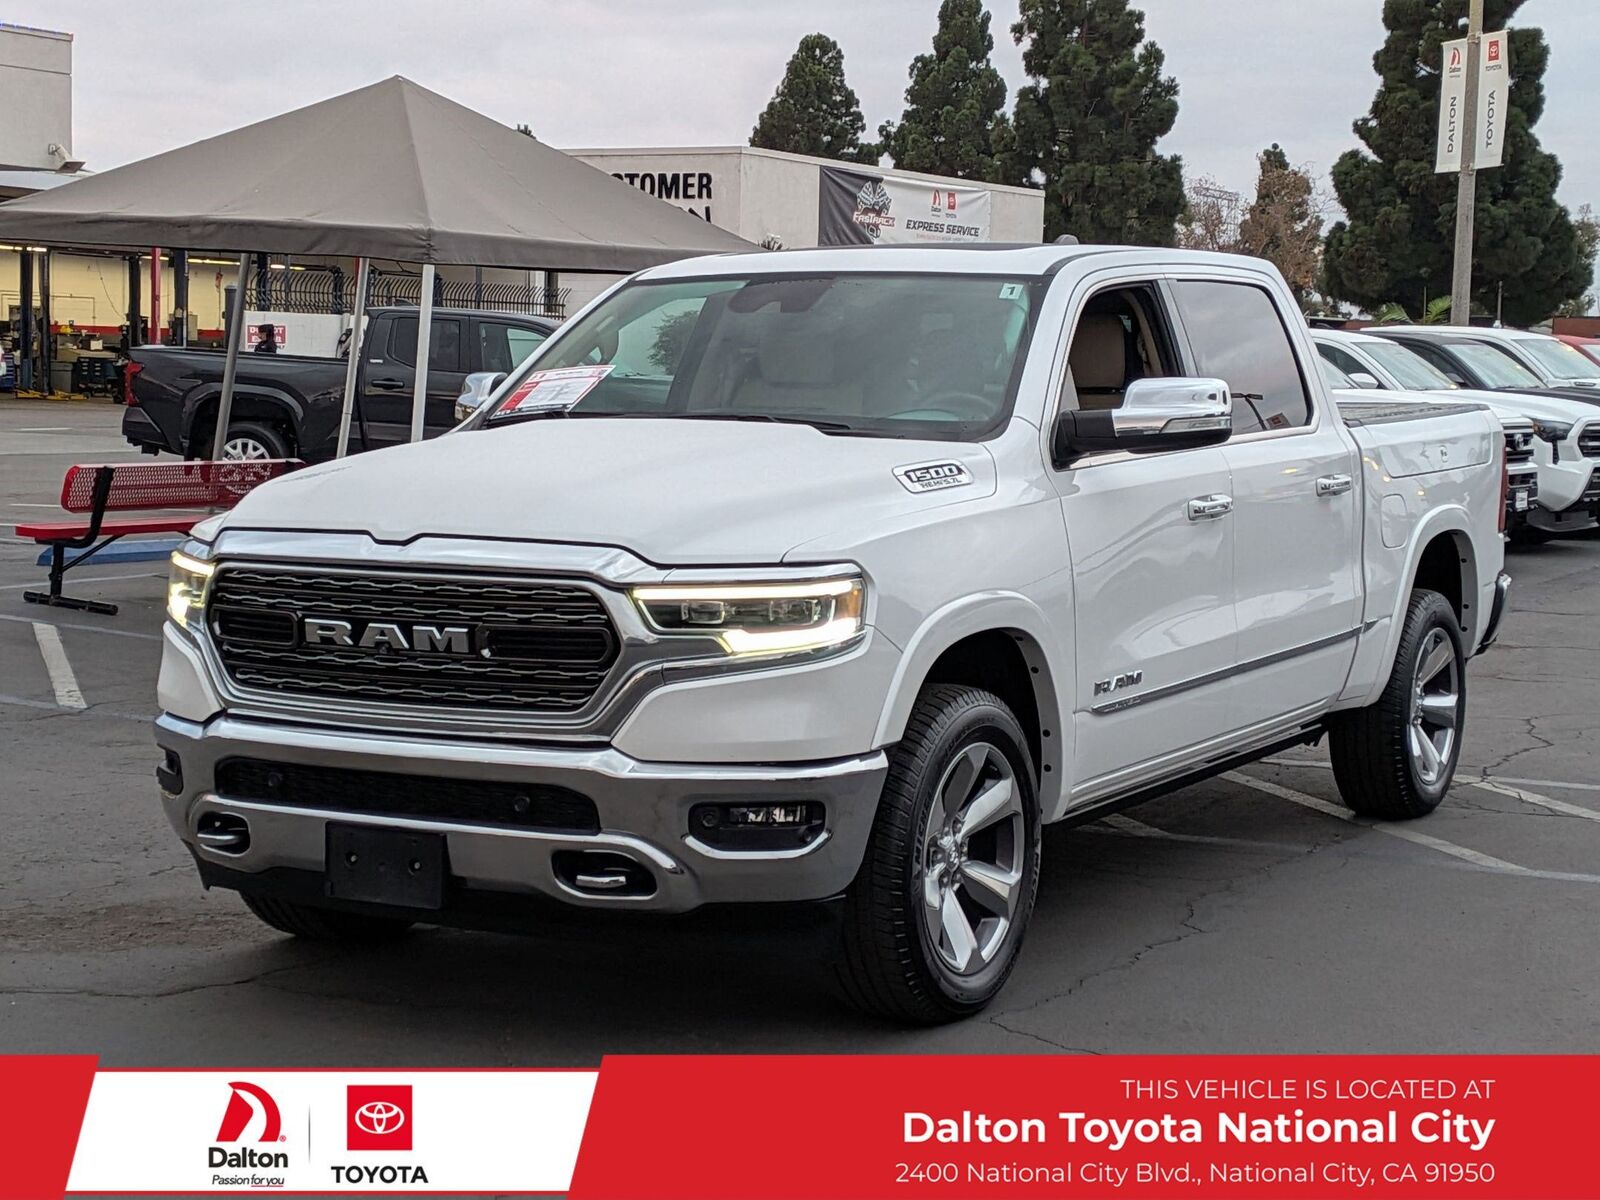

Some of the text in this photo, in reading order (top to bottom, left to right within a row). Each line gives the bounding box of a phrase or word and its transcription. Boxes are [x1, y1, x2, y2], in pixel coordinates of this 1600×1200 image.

[1447, 97, 1456, 153] DALTON
[1486, 90, 1496, 149] TOYOTA
[906, 219, 980, 237] EXPRESS SERVICE
[906, 465, 958, 482] 1500
[304, 618, 469, 653] RAM
[1094, 670, 1143, 696] RAM
